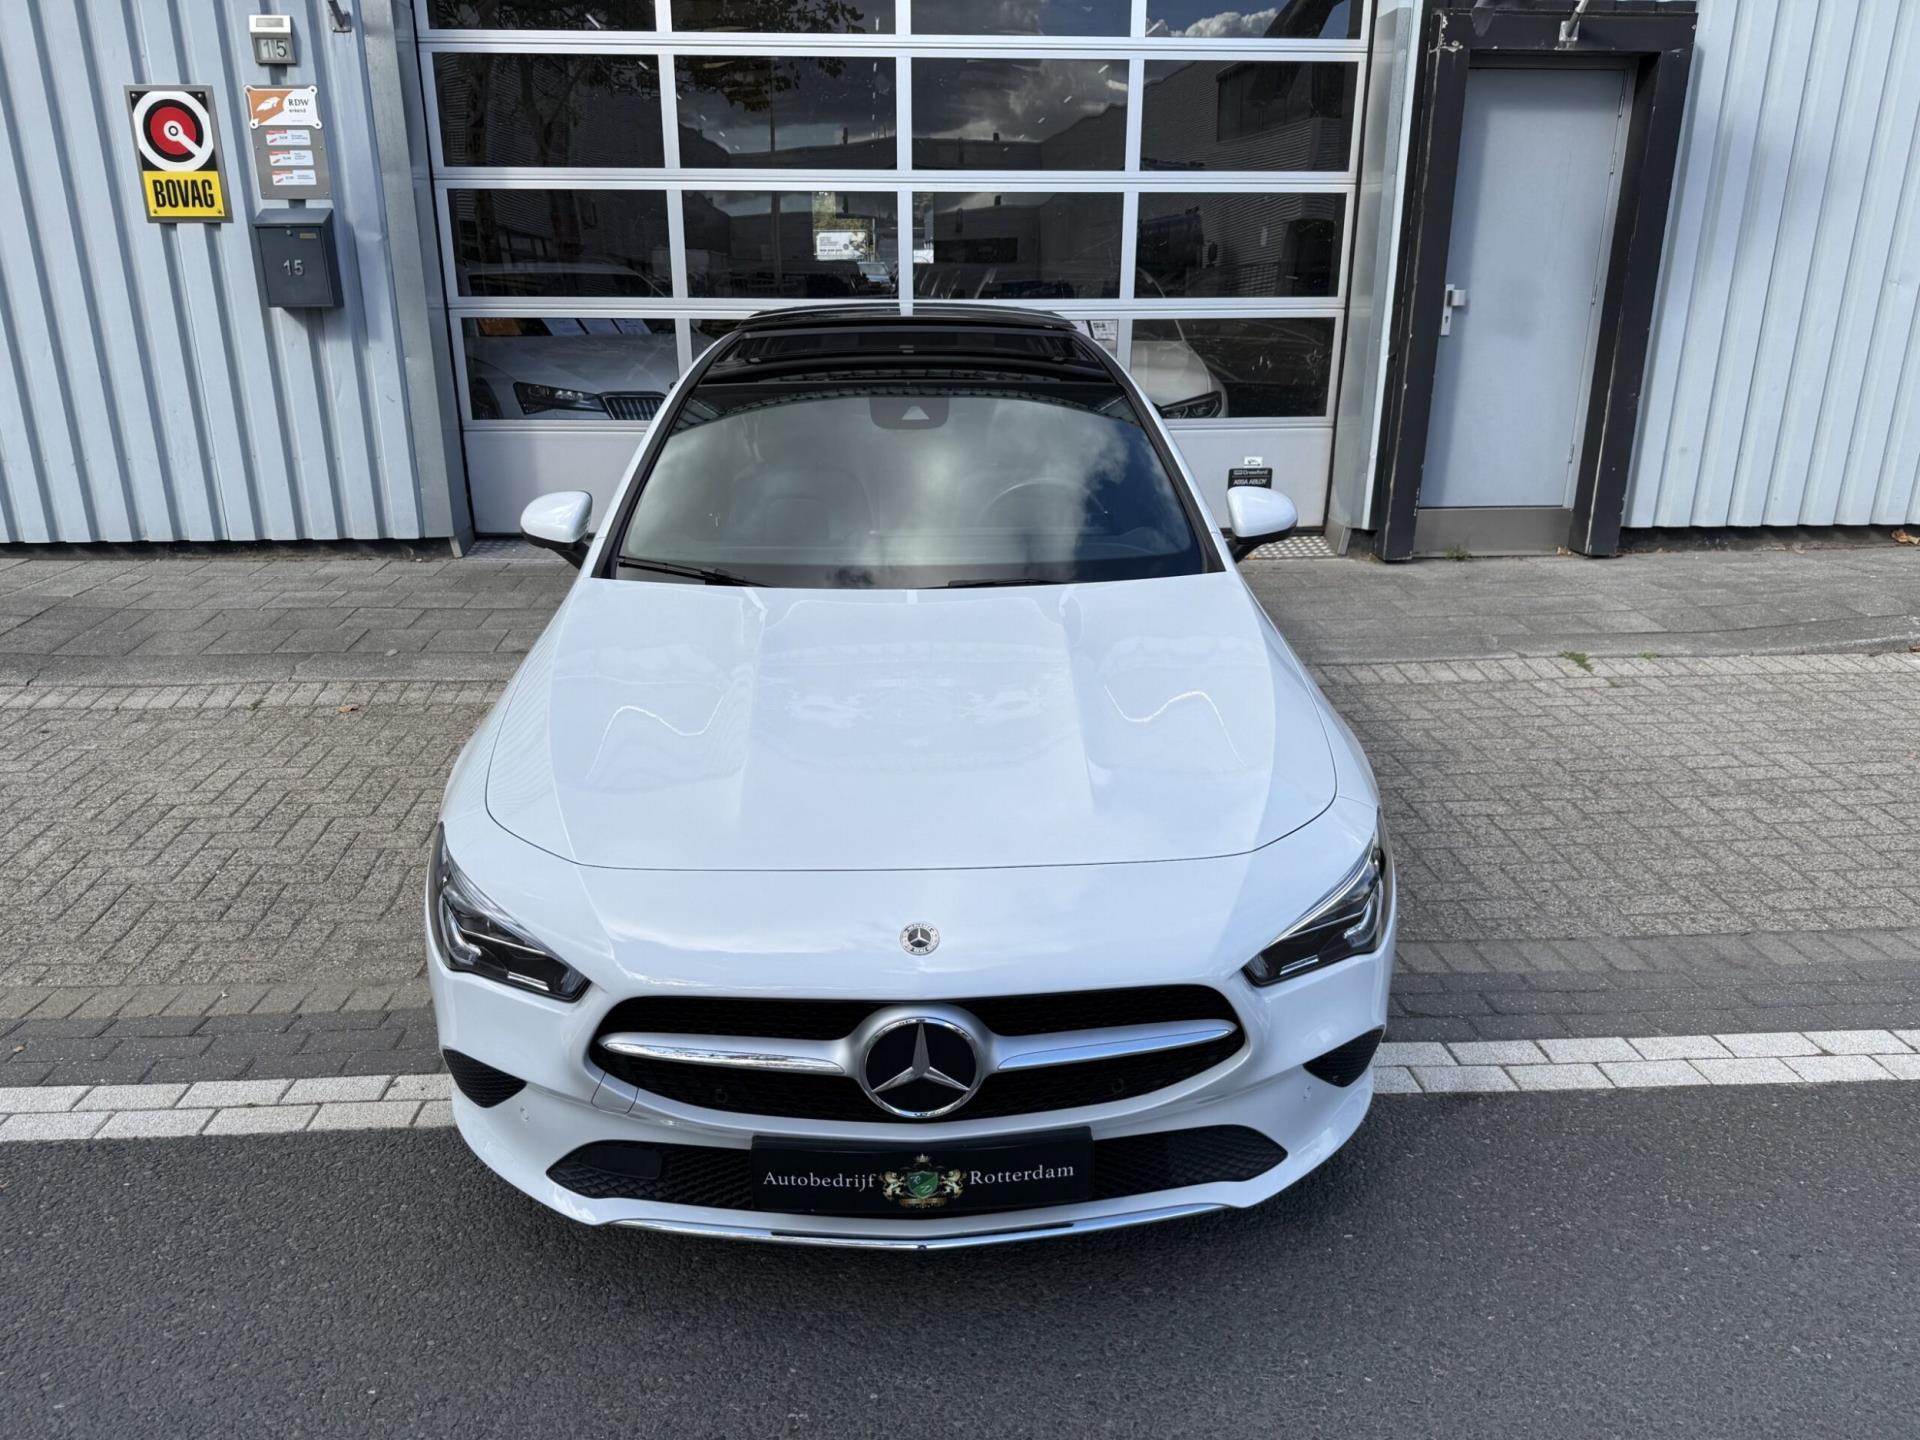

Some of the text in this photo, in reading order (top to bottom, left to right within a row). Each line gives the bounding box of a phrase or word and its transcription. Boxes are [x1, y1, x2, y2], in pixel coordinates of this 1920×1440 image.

[263, 40, 287, 58] 15
[288, 98, 309, 106] RDW
[152, 179, 215, 208] BOVAG
[283, 259, 304, 276] 15
[763, 1164, 1074, 1192] Autobedrijf Rotterdam
